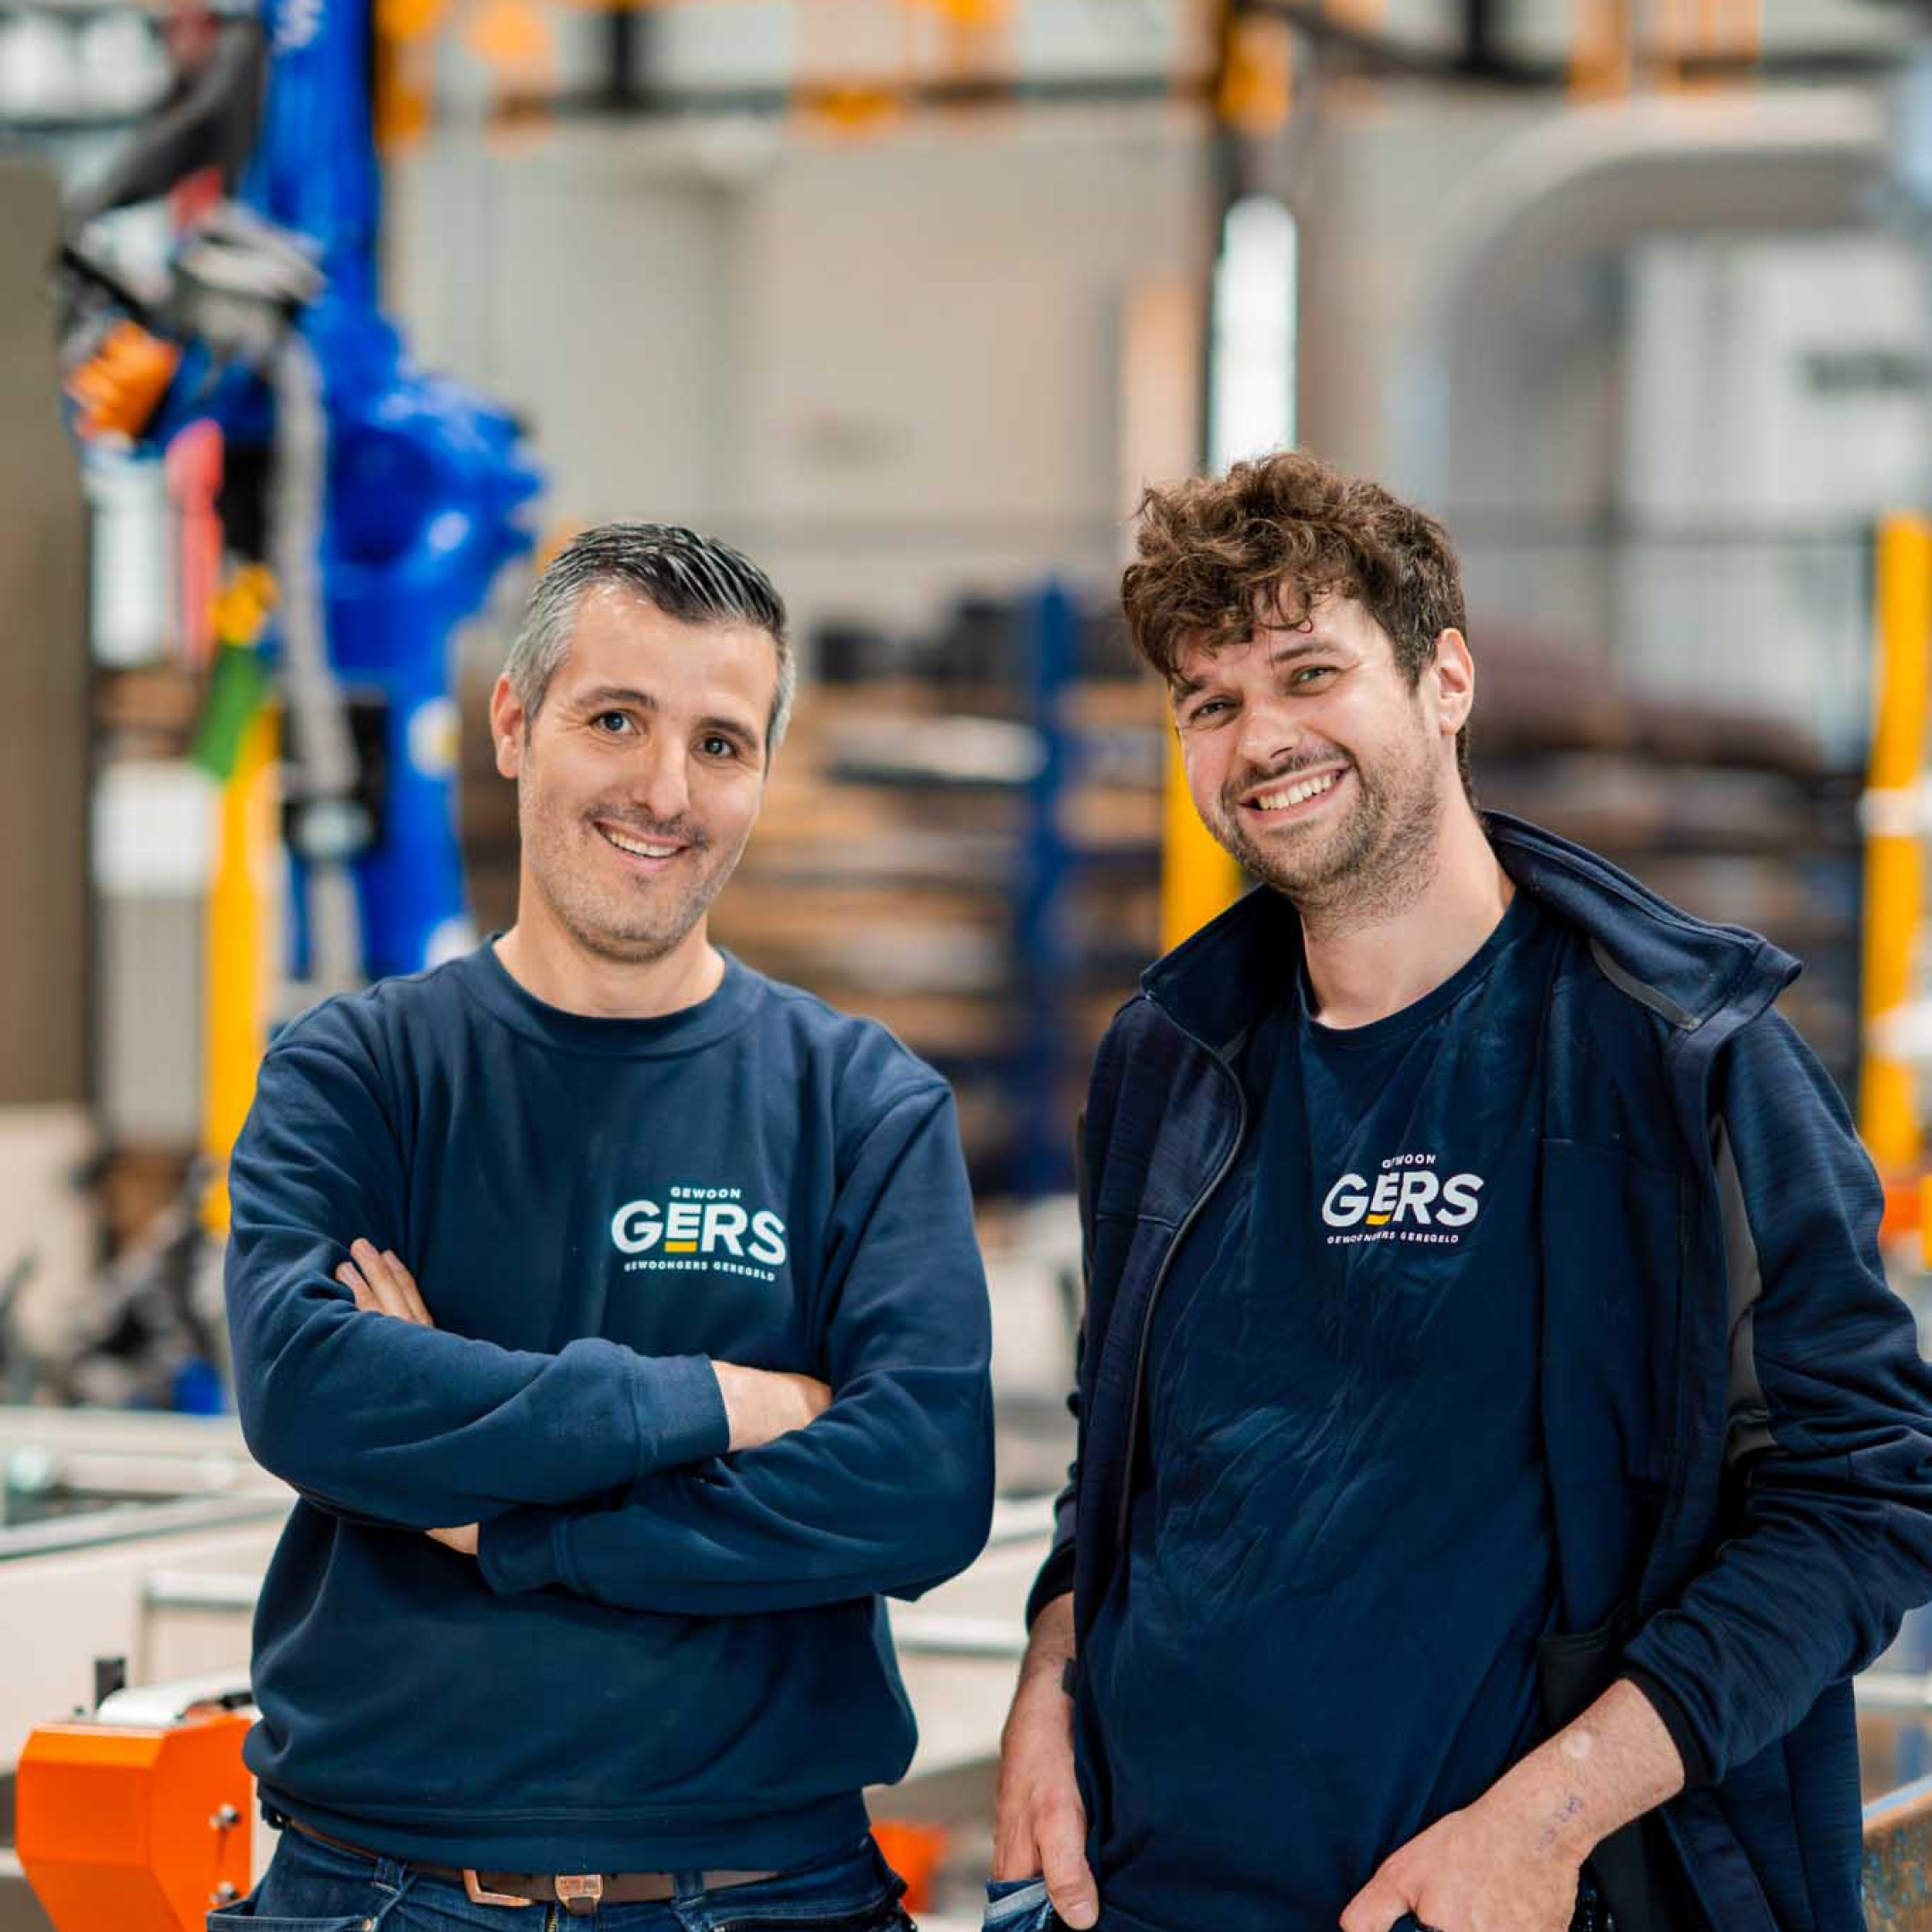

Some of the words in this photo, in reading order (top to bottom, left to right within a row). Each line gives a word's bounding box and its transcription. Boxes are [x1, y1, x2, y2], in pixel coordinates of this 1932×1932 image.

[670, 1186, 741, 1199] GEWOON
[1322, 1170, 1485, 1227] GERS
[611, 1199, 787, 1265] GERS
[713, 1260, 775, 1283] GEREGELD
